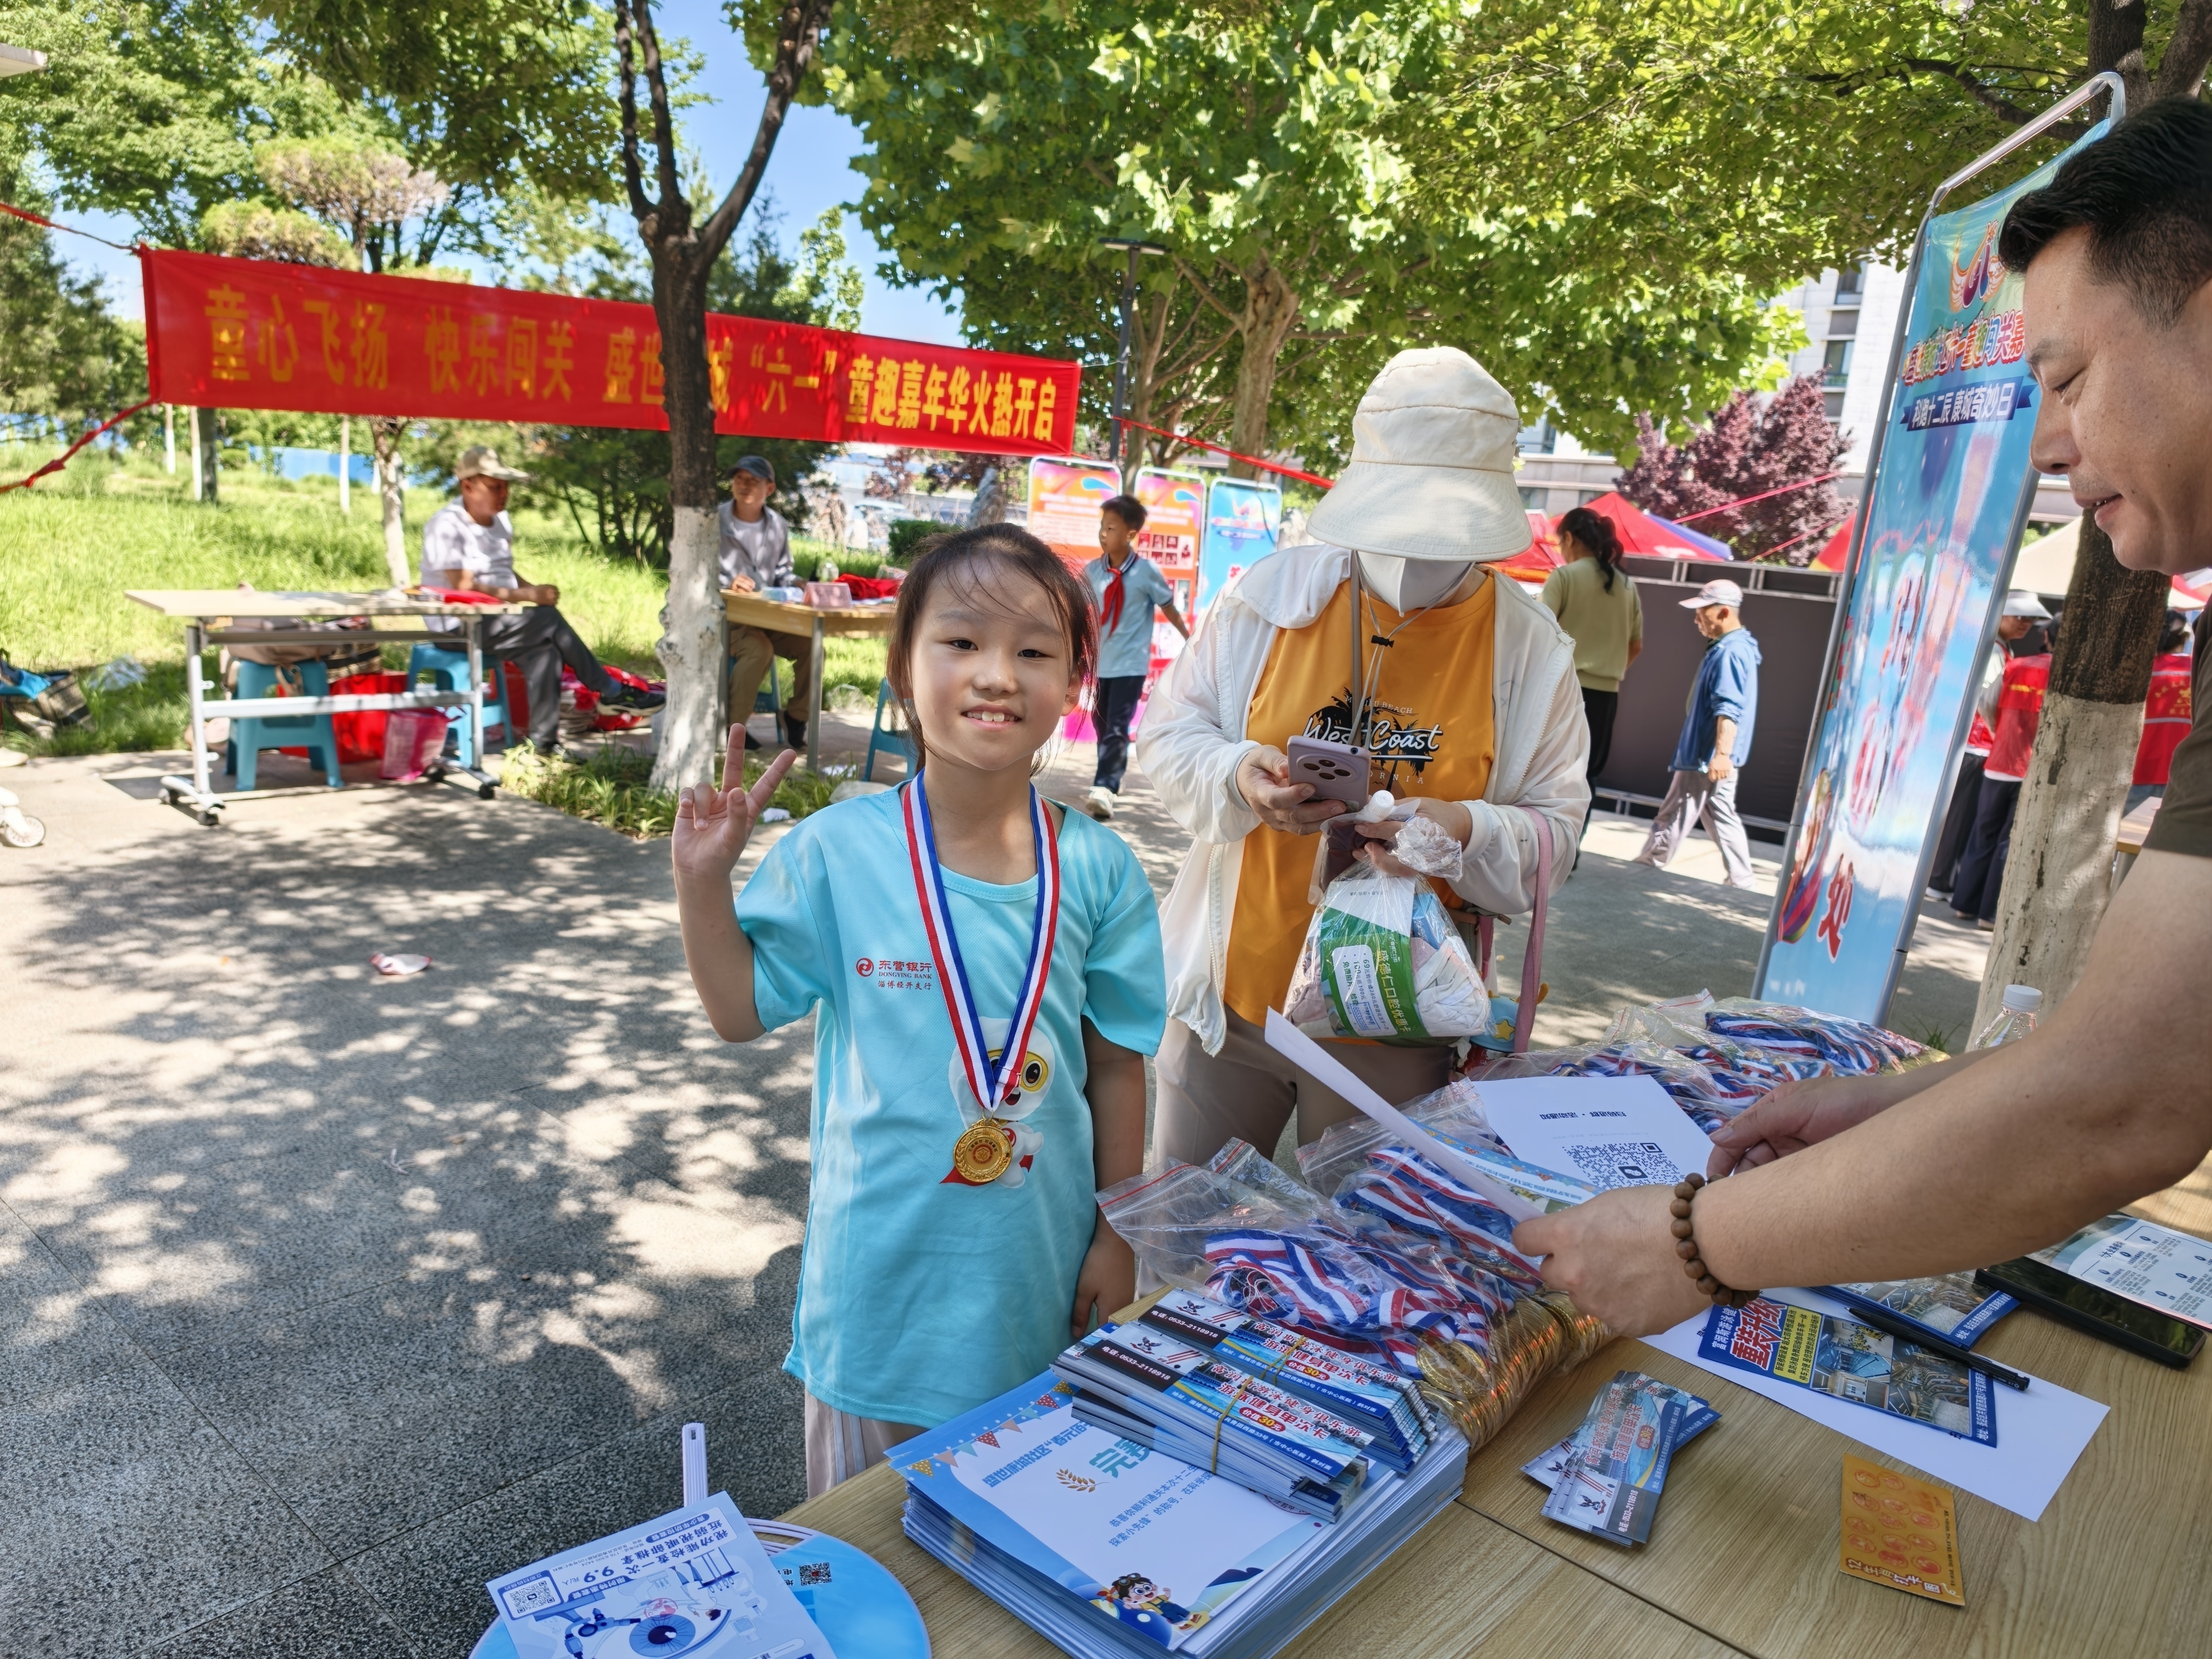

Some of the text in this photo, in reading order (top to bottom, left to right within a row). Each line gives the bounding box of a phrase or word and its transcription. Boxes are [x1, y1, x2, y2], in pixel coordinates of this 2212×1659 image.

[205, 284, 1057, 442] 童心飞扬 快乐闯关 盛世城“六一”童趣嘉年华火热开启
[1382, 702, 1413, 714] BEACH
[1303, 717, 1443, 751] Wes Coast
[879, 960, 932, 973] 东营银行
[878, 980, 932, 990] 淄博经开支行
[1378, 949, 1412, 1033] 盛德仁口腔优惠卡
[1539, 1111, 1579, 1120] 活动通知
[1711, 1306, 1738, 1350] 富润斯游泳健
[1730, 1297, 1788, 1371] 重装升级
[1255, 1321, 1400, 1383] 富润斯游泳健身俱乐部
[1263, 1338, 1372, 1386] 游泳健身单次卡
[1287, 1360, 1327, 1381] 价值30元
[1799, 1363, 1811, 1381] 停车方便
[1211, 1364, 1363, 1438] 富润斯游泳健身俱乐部
[1217, 1381, 1331, 1440] 游泳健身单次卡
[1242, 1407, 1283, 1431] 价值30元
[1584, 1388, 1623, 1465] 富润斯游泳健身俱乐部
[1610, 1403, 1643, 1462] 游泳健身单次卡
[1638, 1426, 1655, 1448] 价值30元
[1109, 1464, 1200, 1527] 恭喜你顺利通关本次十二生
[622, 1519, 723, 1566] 近弱视眼部推拿
[649, 1514, 704, 1542] 青少年防控套餐
[625, 1528, 729, 1575] 视功能检查一次
[504, 1574, 543, 1590] 立即扫码预约
[561, 1566, 615, 1586] 9.9 元/人
[571, 1576, 626, 1599] 限时特惠套餐
[1847, 1558, 1942, 1594] 12生肖打卡图
